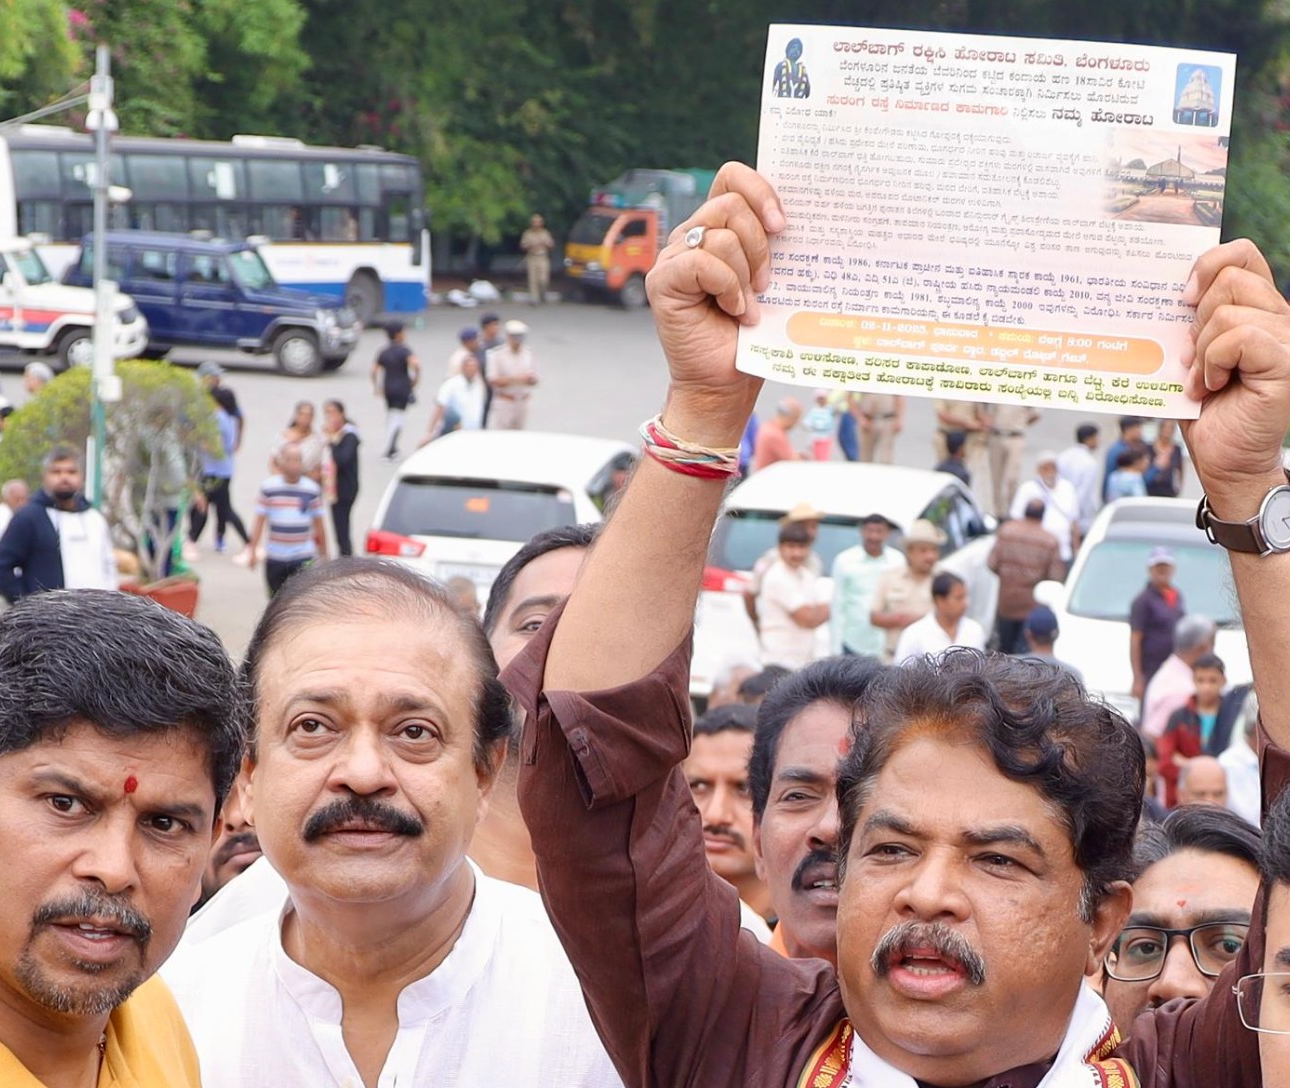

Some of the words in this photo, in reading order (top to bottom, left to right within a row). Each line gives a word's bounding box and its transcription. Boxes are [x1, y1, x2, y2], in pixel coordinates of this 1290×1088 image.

[833, 39, 904, 55] ಲಾಲ್‌ಬಾಗ್
[912, 45, 946, 63] ರಕ್ಷಿಸಿ
[954, 46, 1016, 63] ಹೋರಾಟ
[1075, 53, 1149, 72] ಬೆಂಗಳೂರು
[826, 94, 865, 106] ಸುರಂಗ
[1052, 108, 1082, 127] ನಮ್ಮ
[1090, 108, 1153, 125] ಹೋರಾಟ
